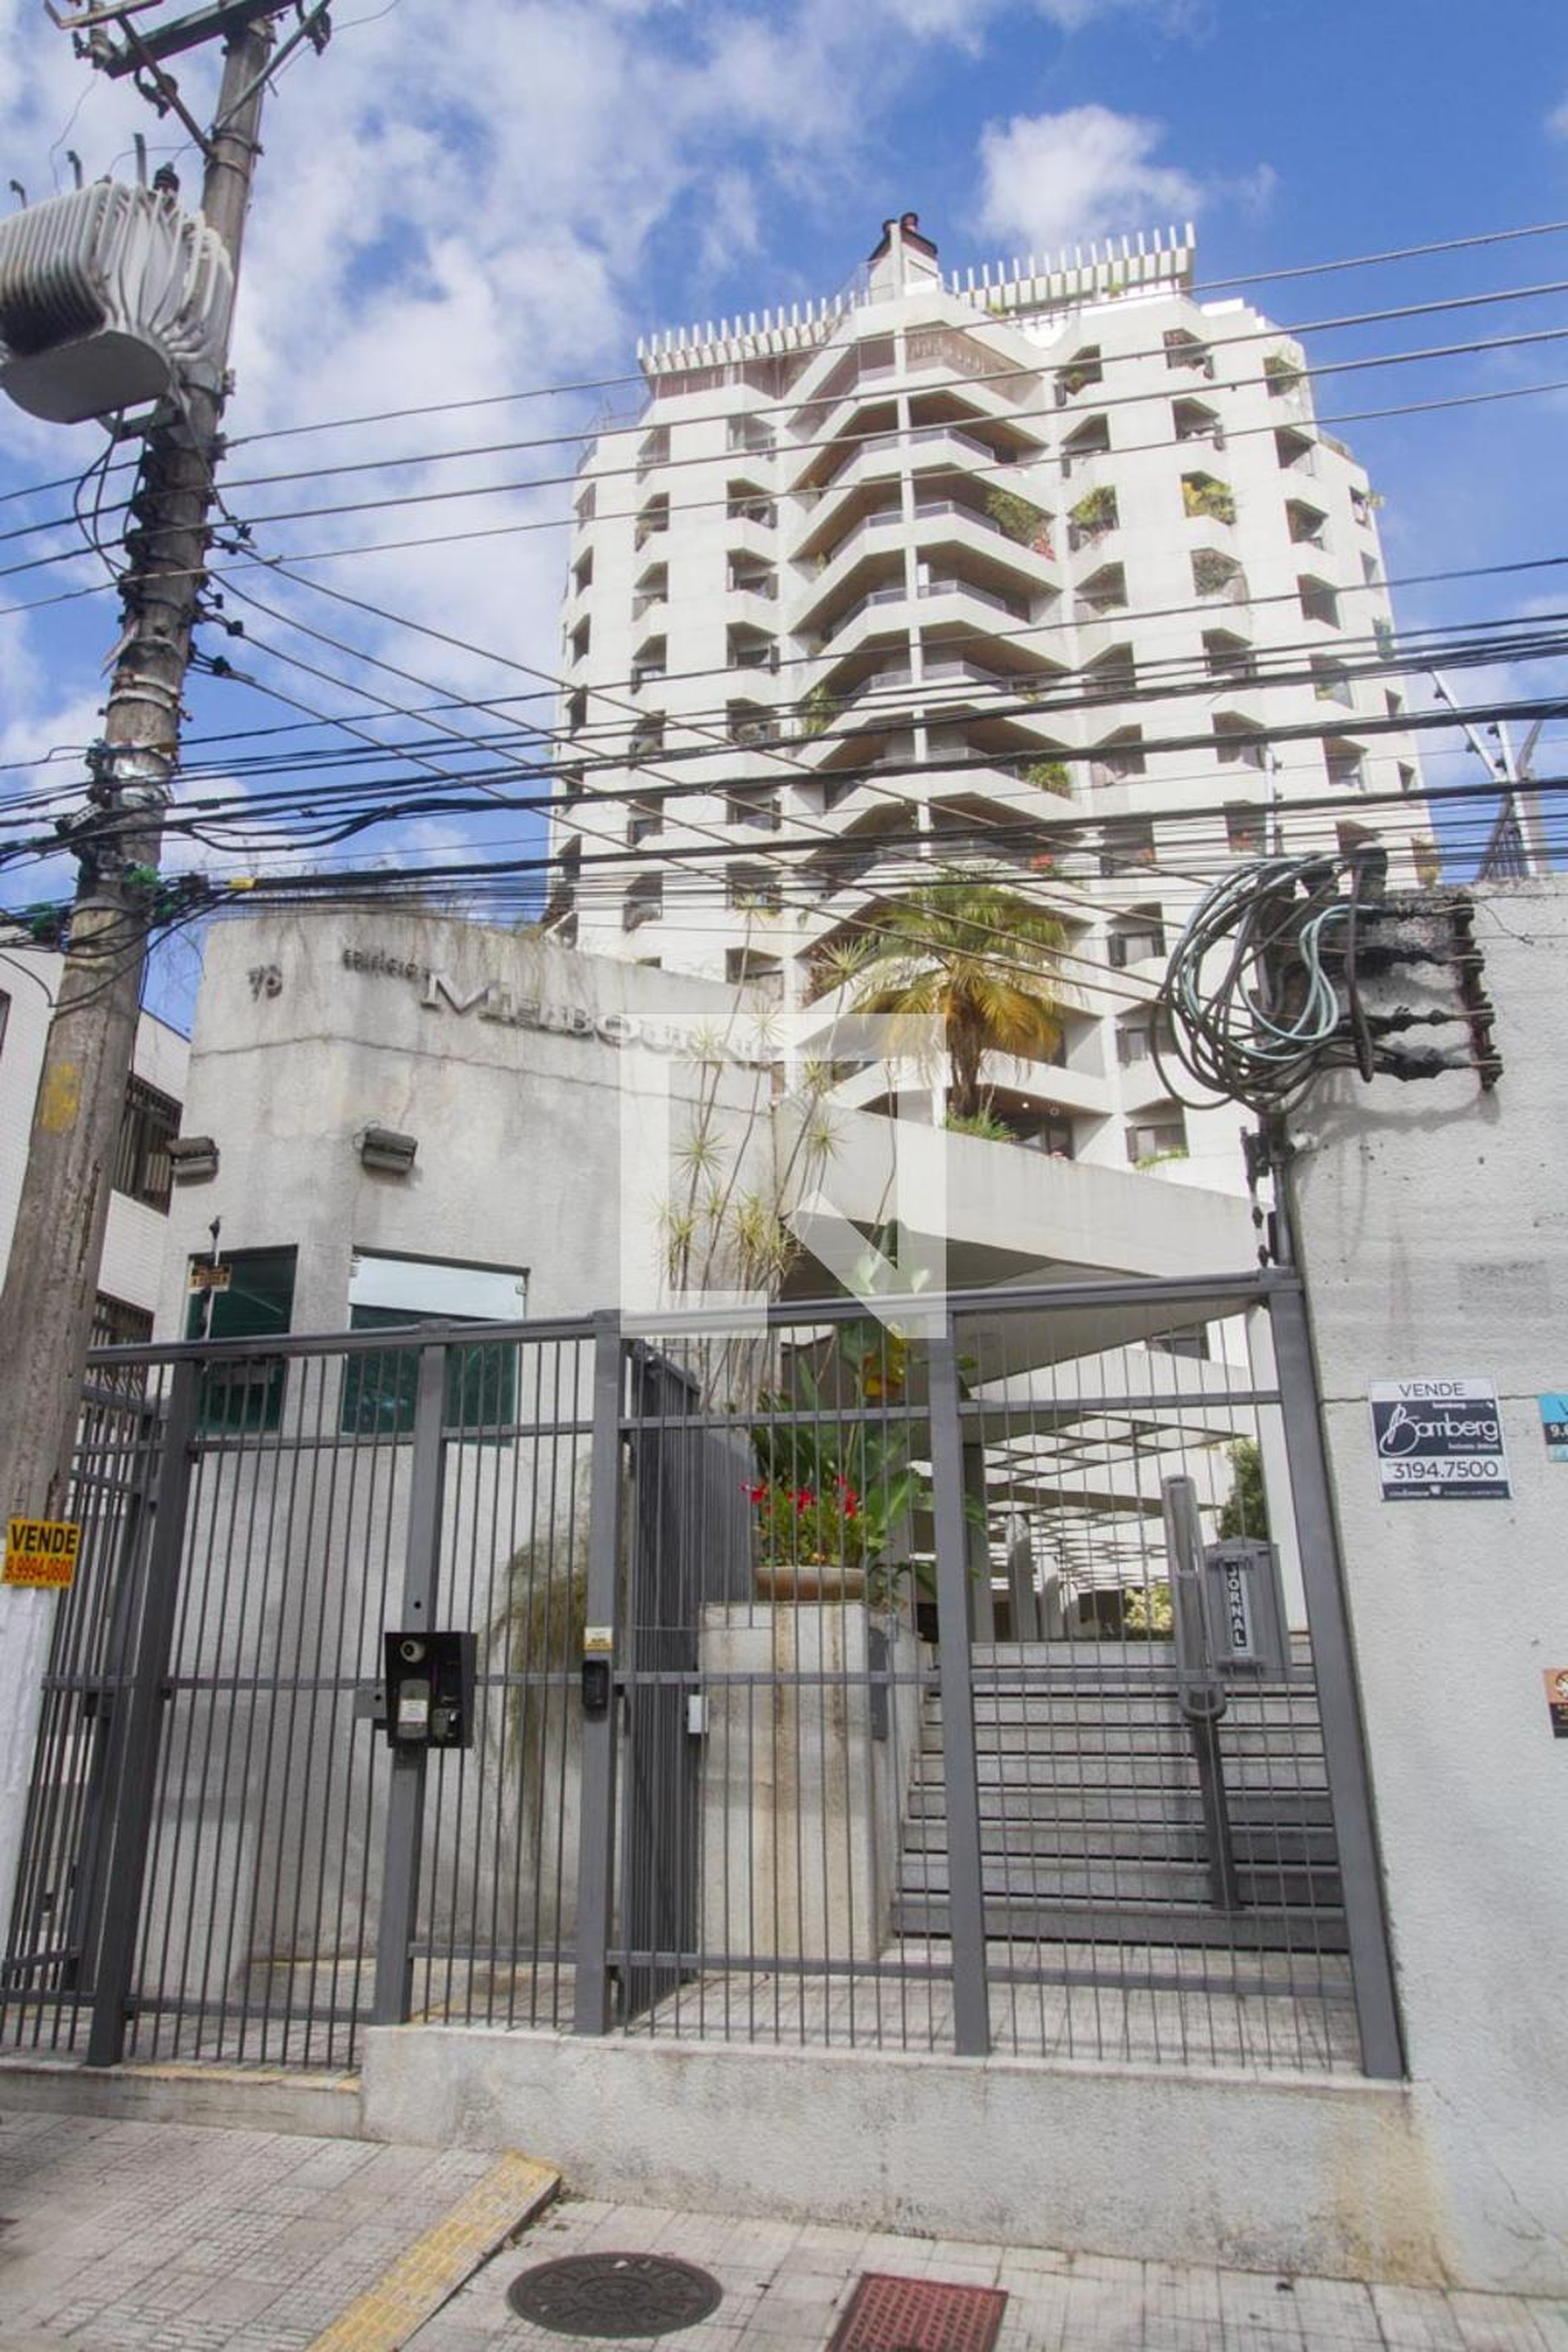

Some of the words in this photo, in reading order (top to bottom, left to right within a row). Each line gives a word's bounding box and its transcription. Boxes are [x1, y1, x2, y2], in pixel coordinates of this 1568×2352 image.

[1398, 1382, 1468, 1396] VENDE
[1379, 1403, 1499, 1456] Bamberg
[1393, 1461, 1499, 1479] 3194.7500
[11, 1523, 78, 1554] VENDE
[1227, 1564, 1246, 1646] JORNAL
